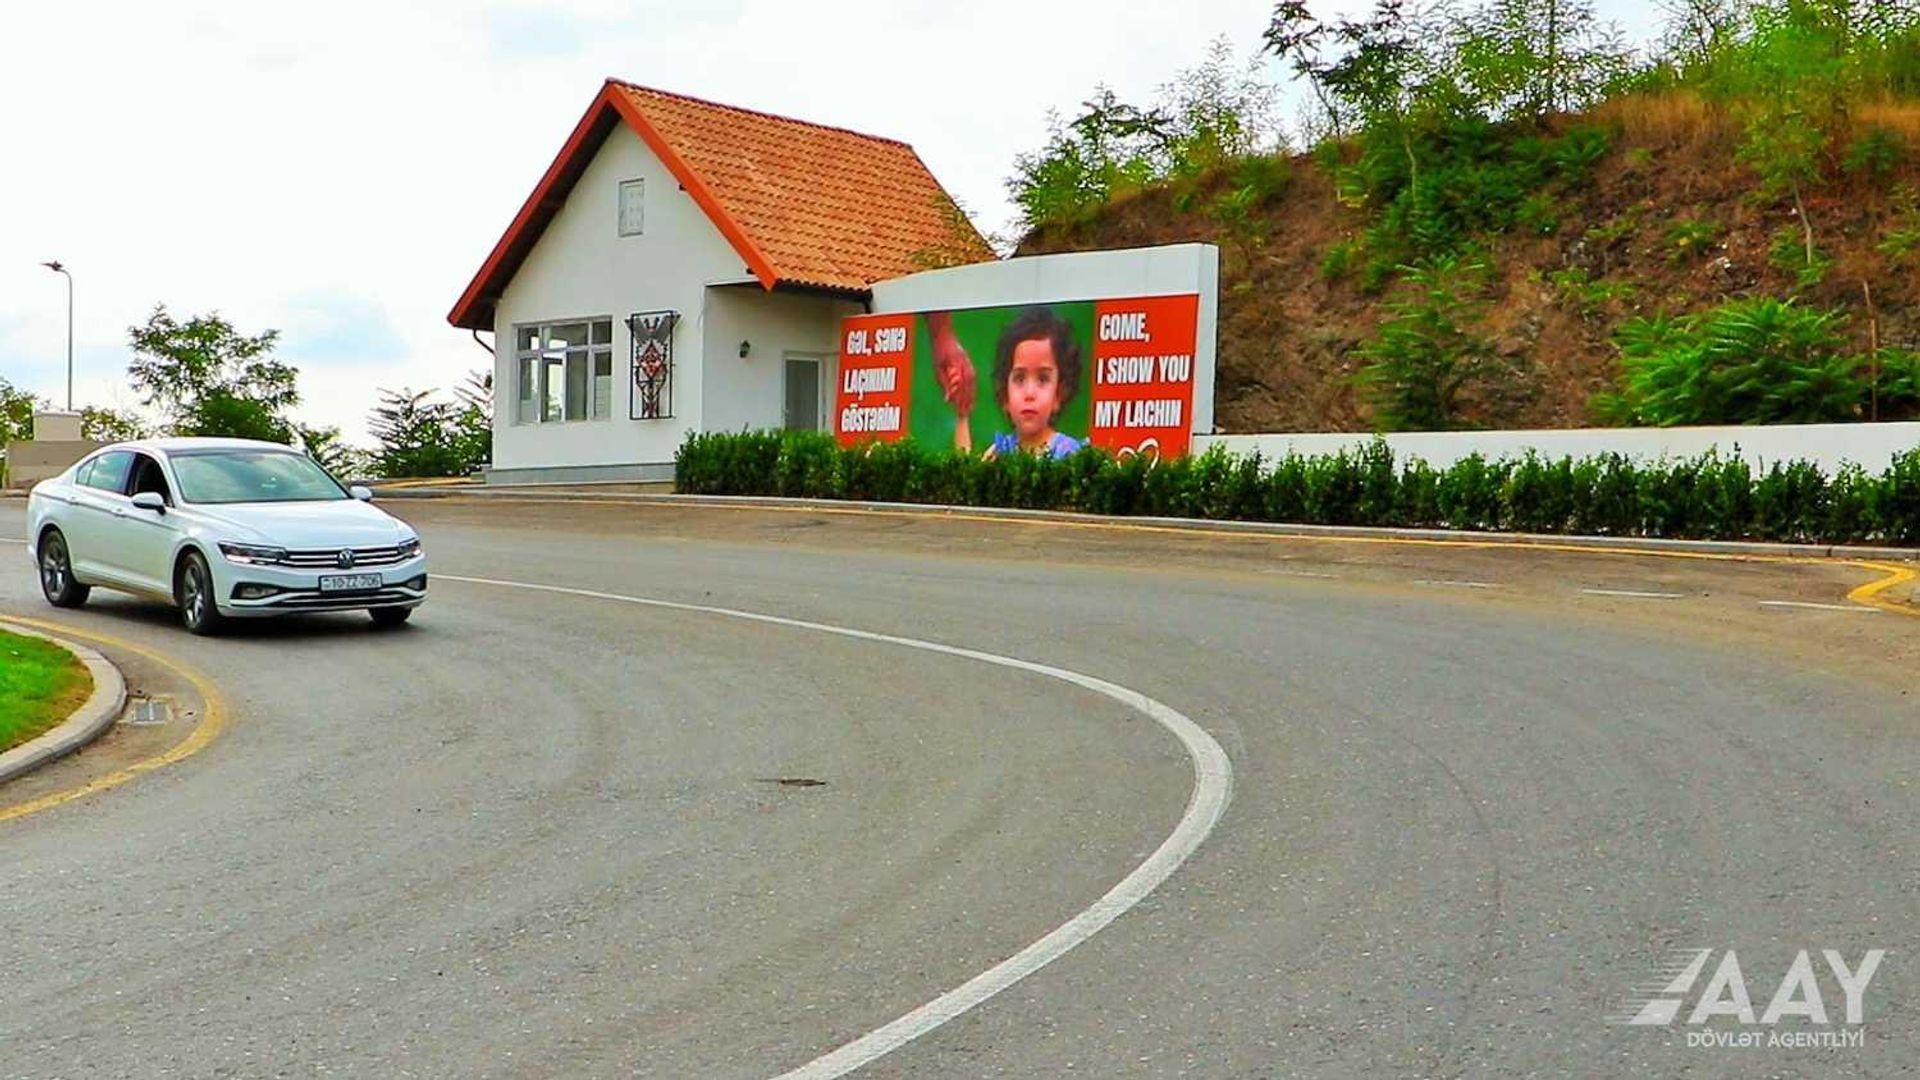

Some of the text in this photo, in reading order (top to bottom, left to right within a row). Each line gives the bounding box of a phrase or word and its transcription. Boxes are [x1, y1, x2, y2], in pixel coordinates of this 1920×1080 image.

[847, 327, 906, 356] GƏL, SƏNƏ
[1100, 313, 1150, 342] COME,
[1097, 355, 1190, 384] I SHOW YOU
[841, 402, 900, 432] GÖSTƏRİM
[1095, 400, 1181, 428] MY LACHIN
